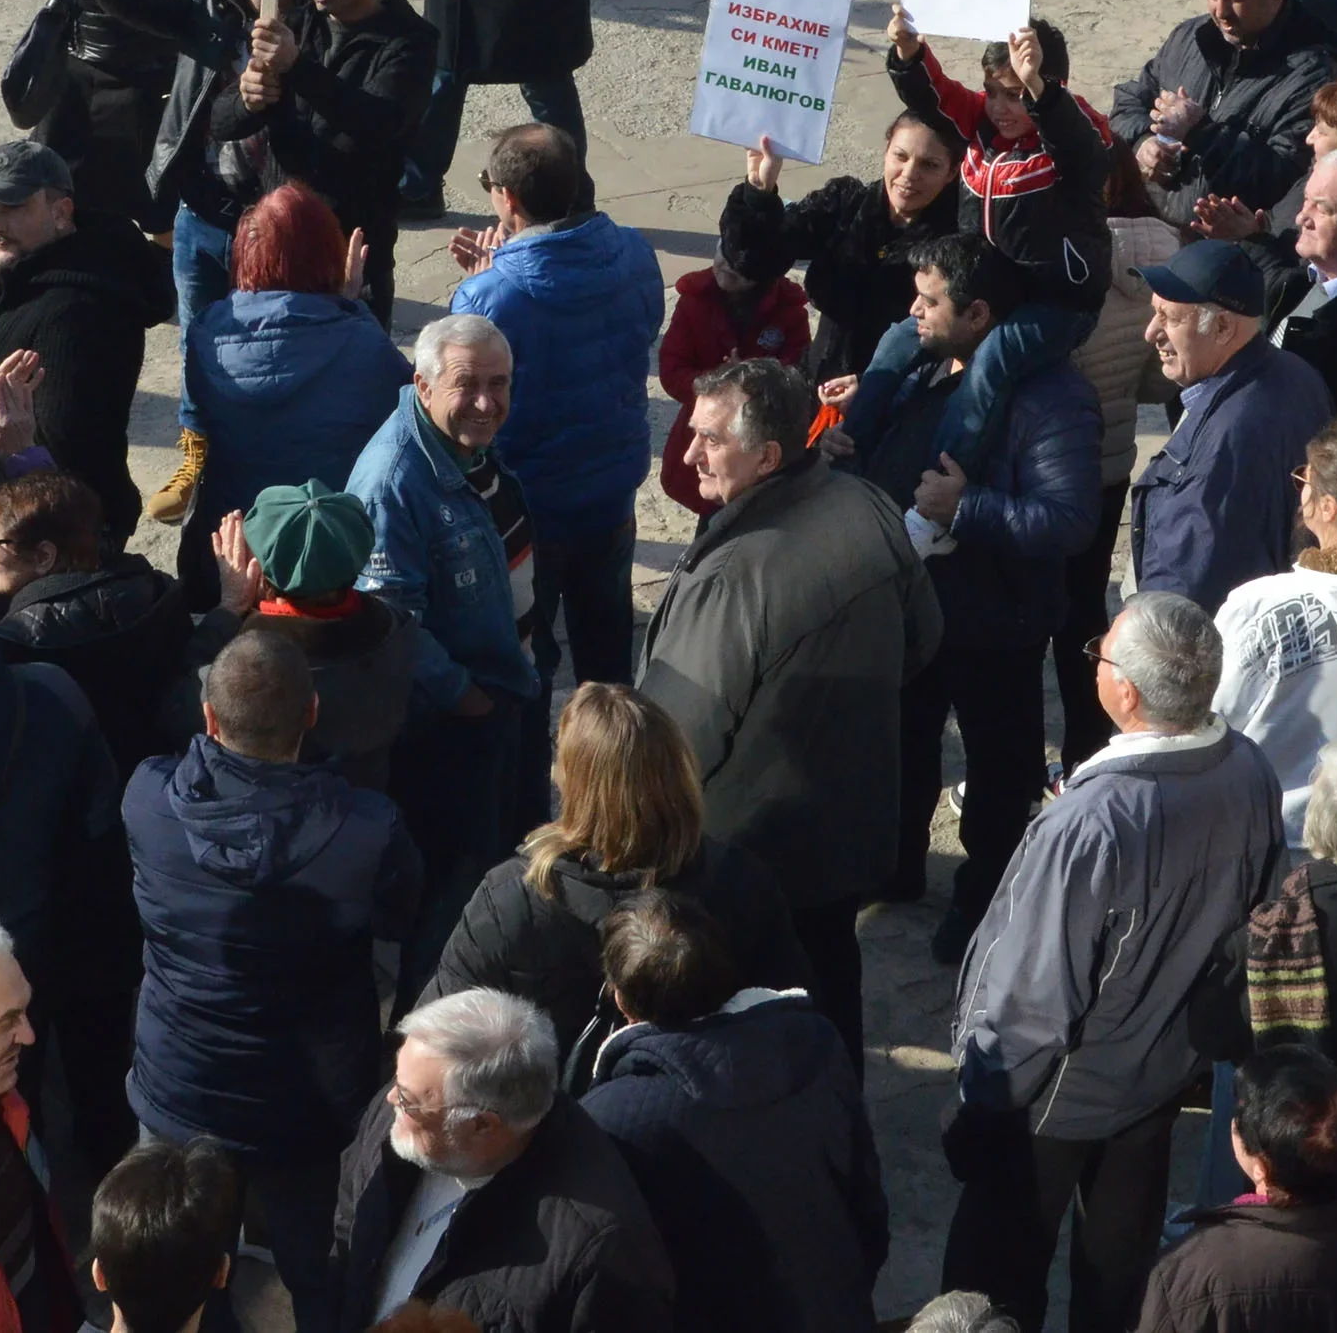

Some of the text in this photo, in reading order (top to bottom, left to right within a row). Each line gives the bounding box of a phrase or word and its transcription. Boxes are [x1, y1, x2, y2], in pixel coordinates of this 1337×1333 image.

[727, 2, 830, 38] ИЗБРАХМЕ
[730, 28, 819, 60] СИ КМЕТ!
[743, 55, 797, 80] ИВАН
[704, 71, 826, 112] ГАВАЛЮГОВ
